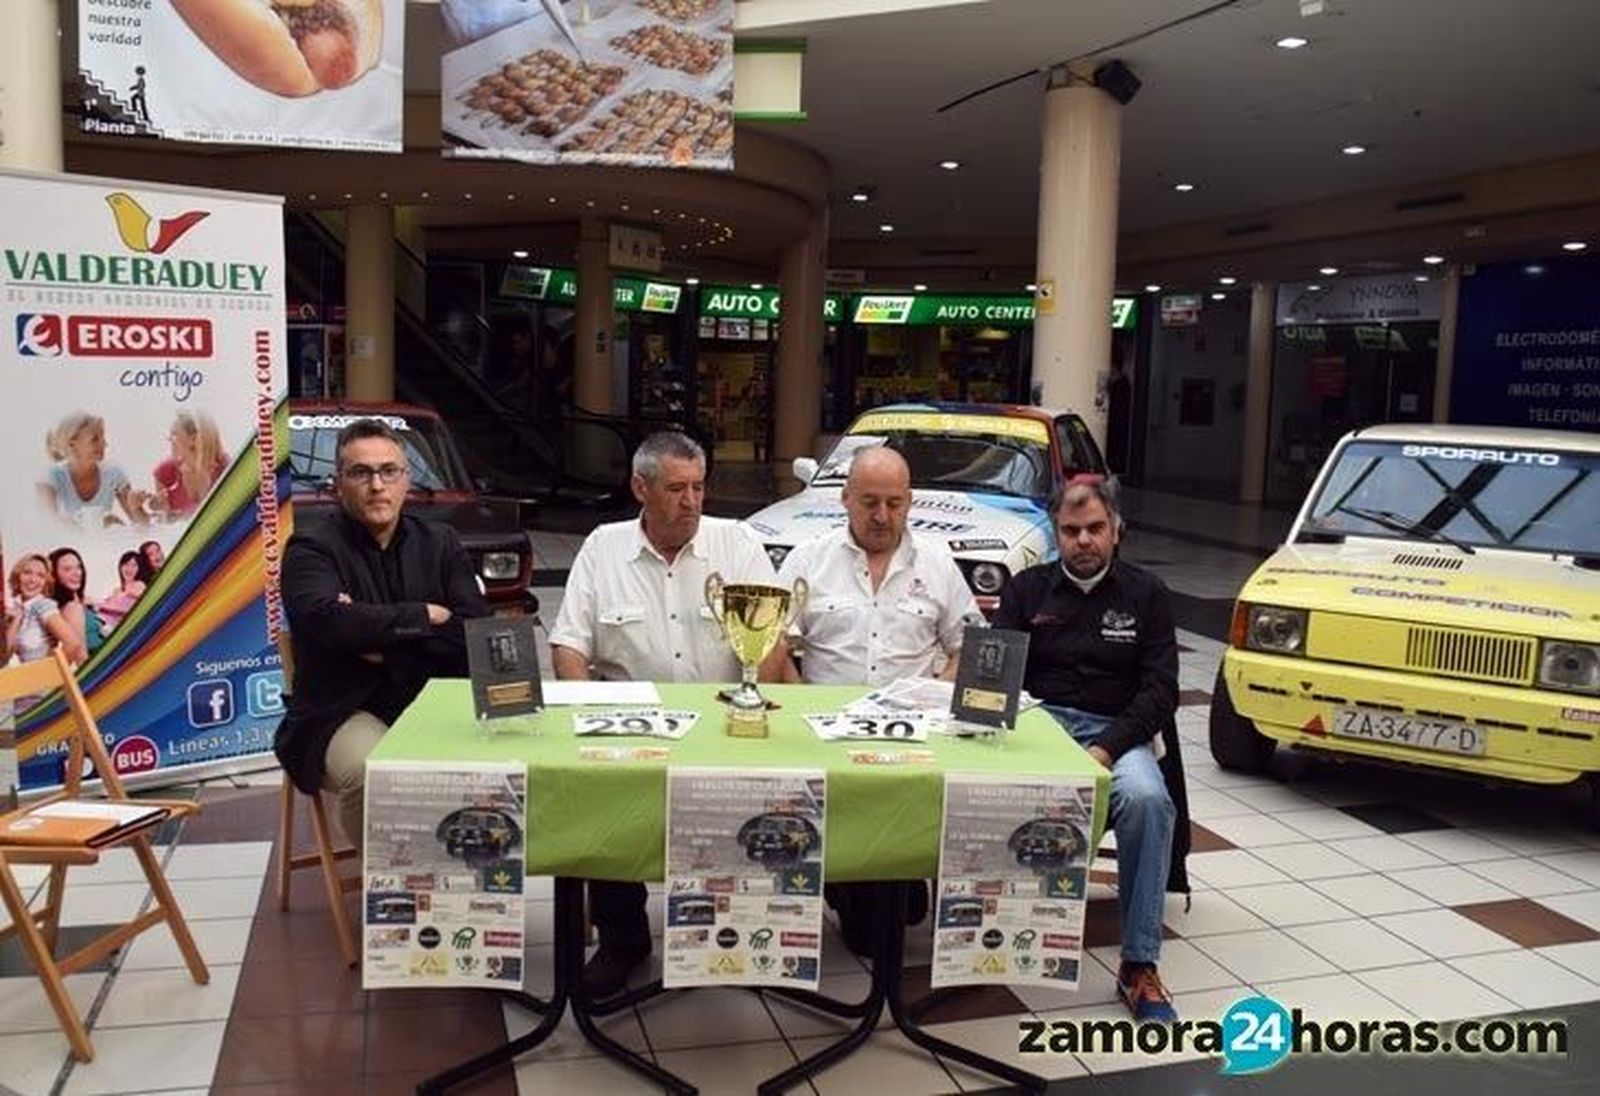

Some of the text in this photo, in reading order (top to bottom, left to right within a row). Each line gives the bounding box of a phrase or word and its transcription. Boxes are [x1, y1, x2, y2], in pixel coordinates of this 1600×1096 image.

[88, 14, 141, 27] nuestra
[84, 118, 136, 134] Planta
[5, 250, 268, 291] VALDERADUEY
[708, 293, 762, 312] AUTO
[937, 304, 979, 319] AUTO
[78, 324, 203, 350] EROSKI
[120, 361, 203, 402] contigo
[1507, 383, 1561, 397] IMAGEN
[1402, 445, 1560, 466] SPORAUTO
[117, 750, 154, 768] BUS
